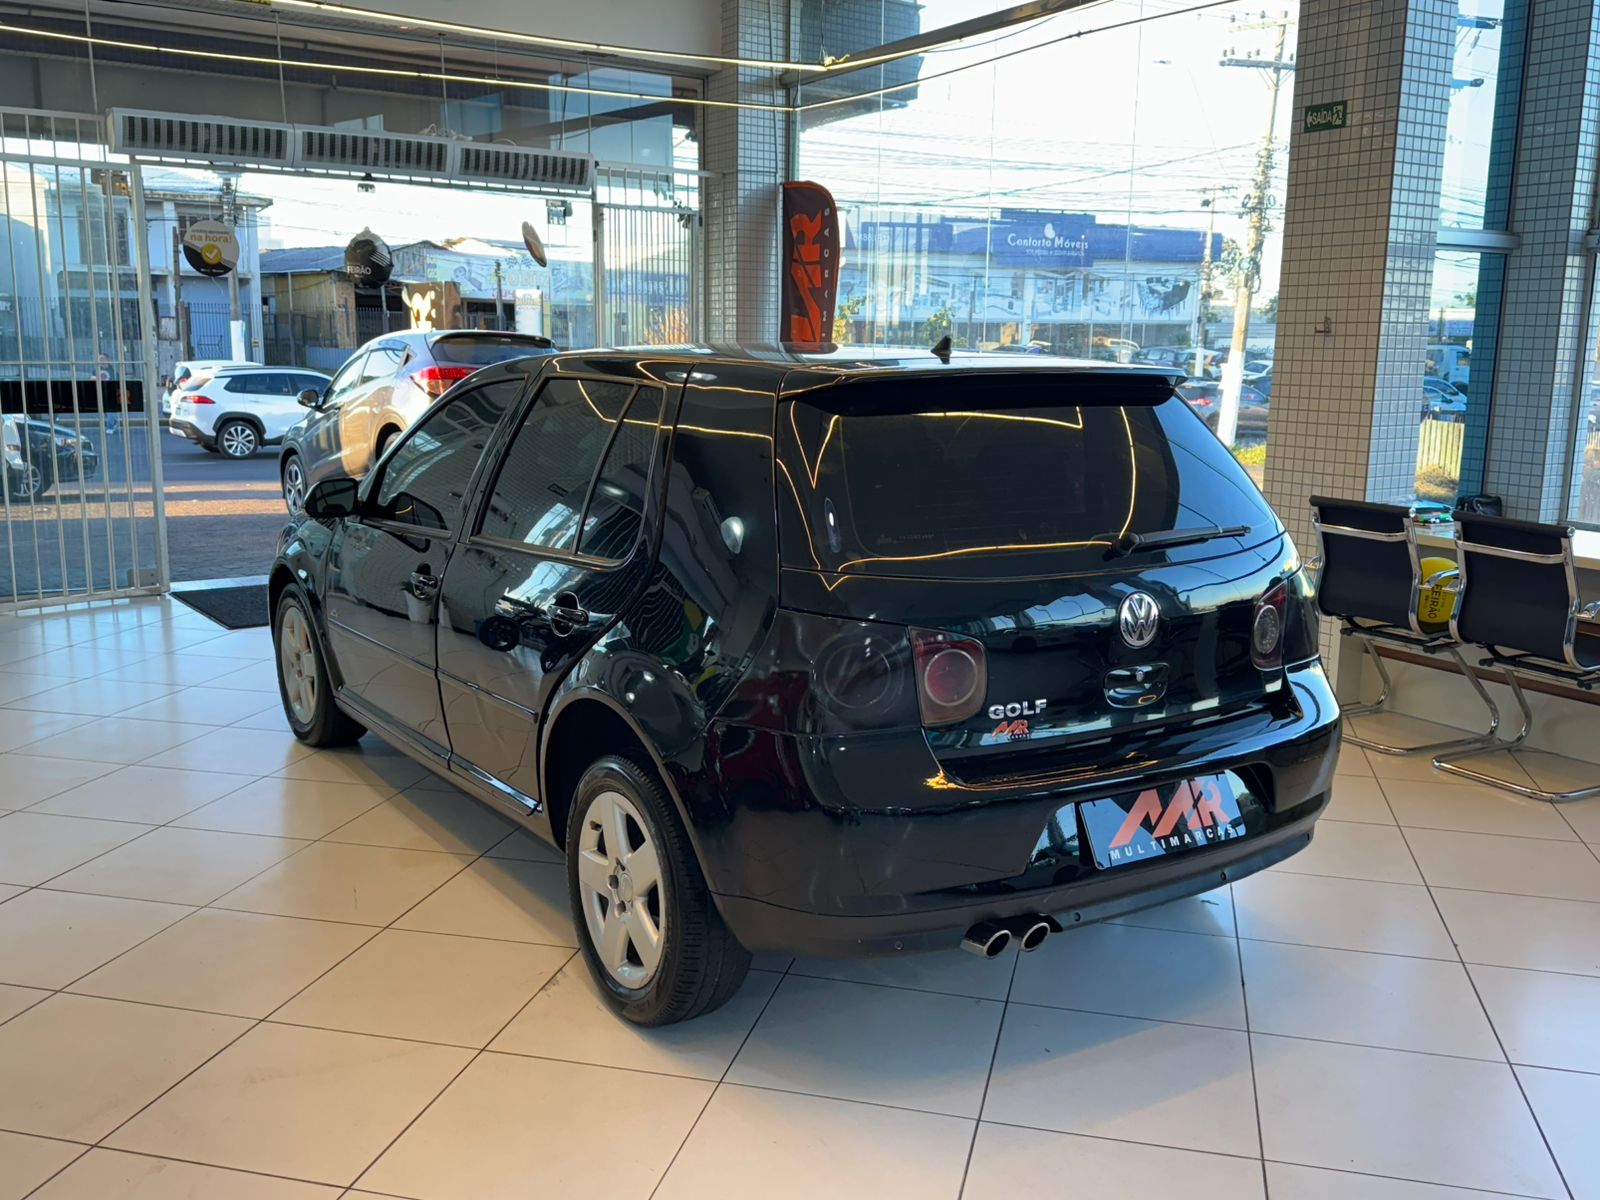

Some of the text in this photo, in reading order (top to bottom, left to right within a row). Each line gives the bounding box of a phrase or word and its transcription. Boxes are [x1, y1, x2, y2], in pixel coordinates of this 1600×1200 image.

[1007, 232, 1089, 249] Conforto Móveis
[988, 698, 1047, 719] GOLF
[1109, 824, 1234, 861] MULTIMARCAS
